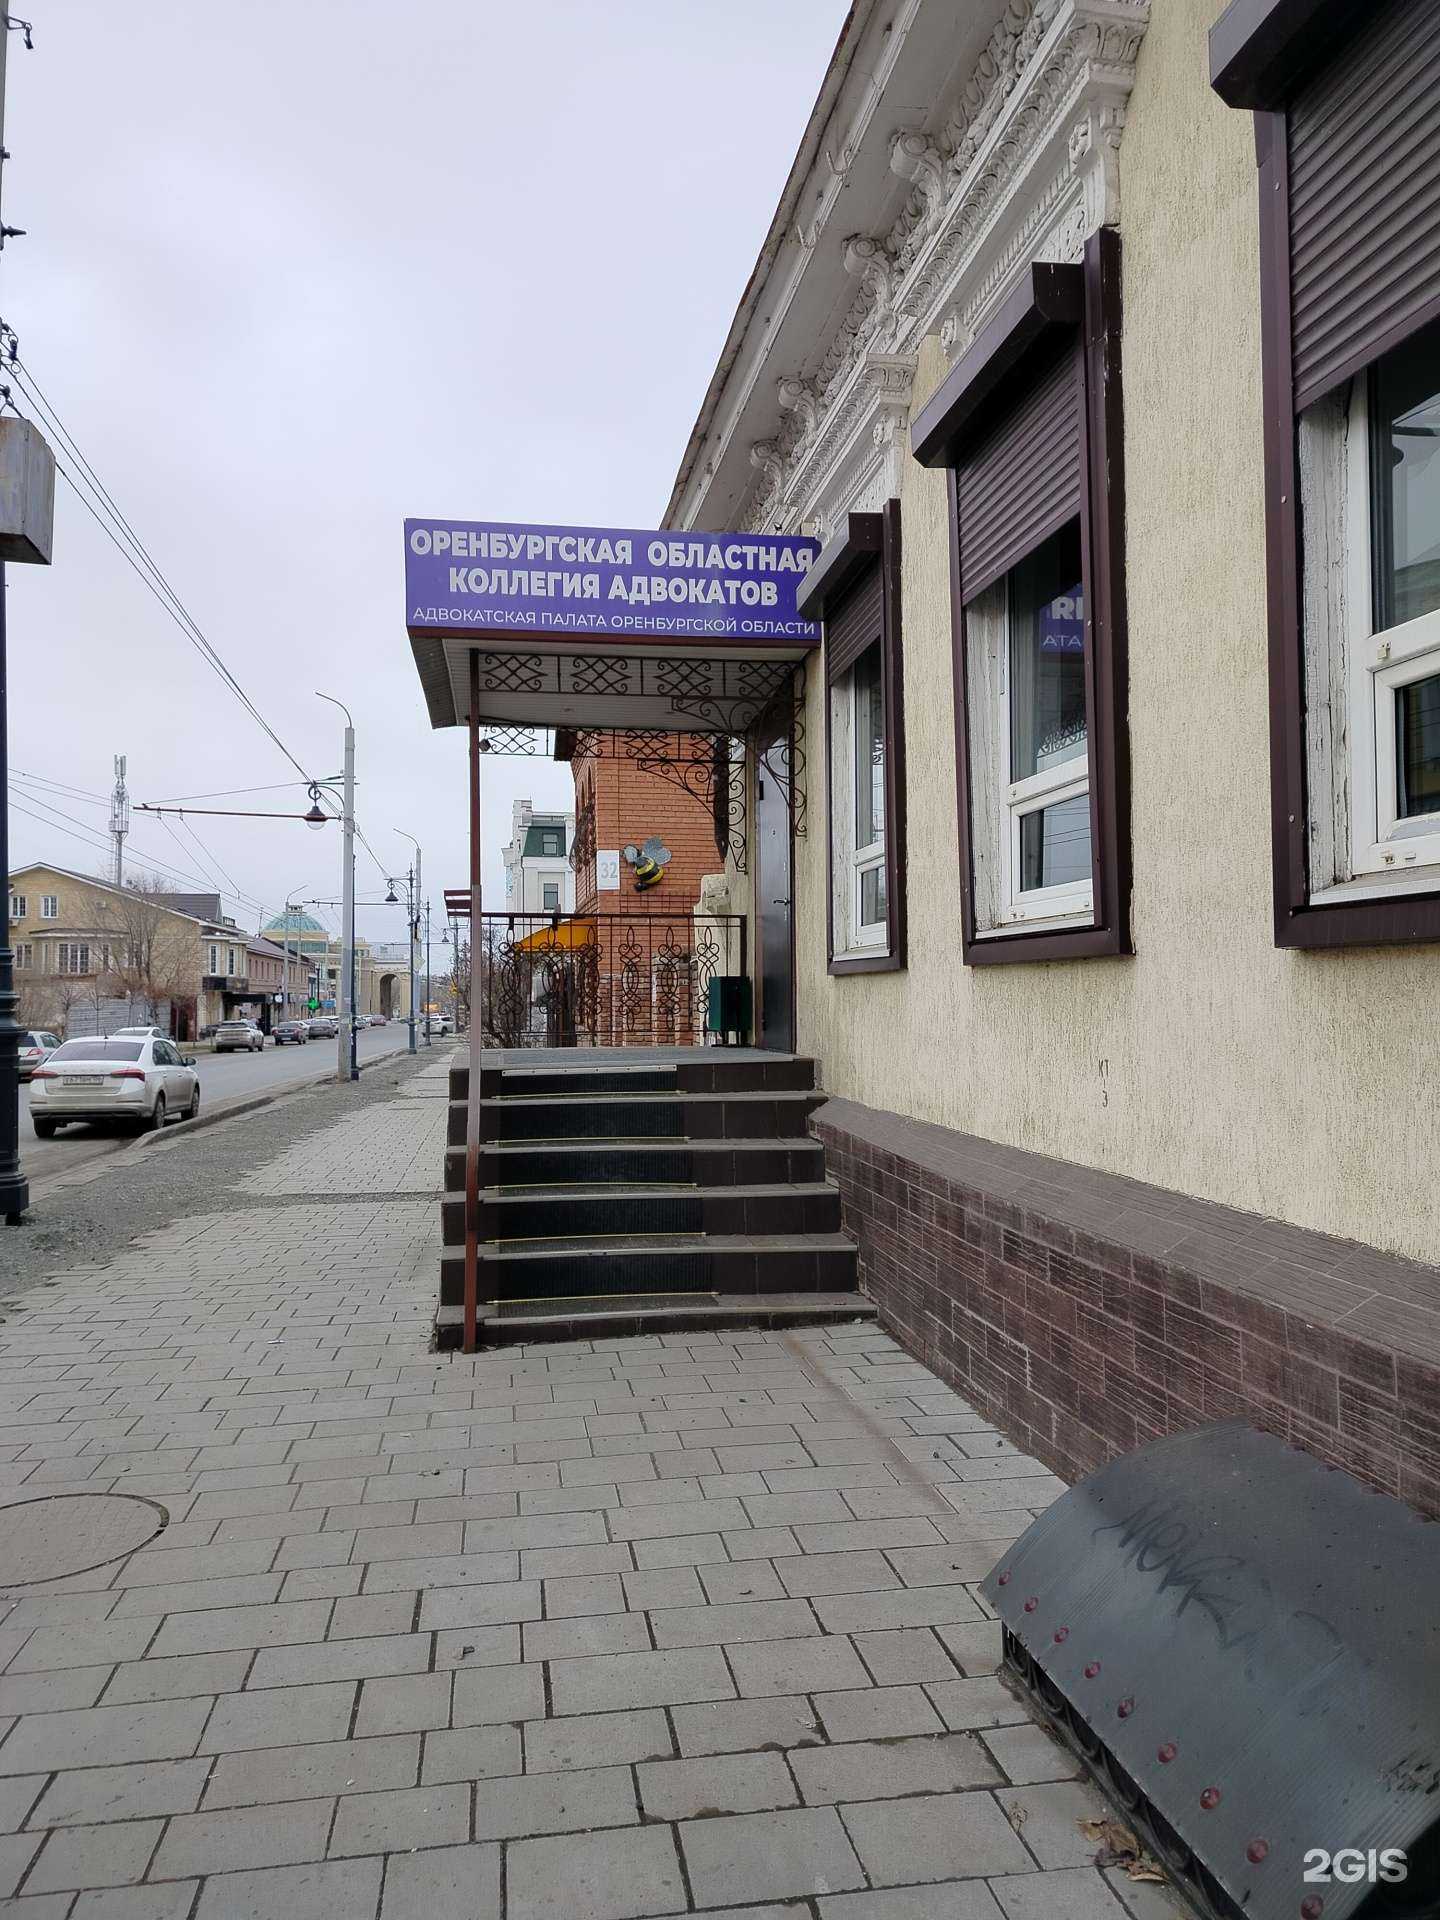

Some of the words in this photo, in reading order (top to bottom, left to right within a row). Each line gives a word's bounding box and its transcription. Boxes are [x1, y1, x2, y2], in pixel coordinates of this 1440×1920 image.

[410, 529, 633, 564] ОРЕНБУРГСКАЯ
[648, 540, 814, 573] ОБЛАСТНАЯ
[449, 568, 600, 598] КОЛЛЕГИЯ
[608, 575, 778, 606] АДВОКАТОВ
[413, 607, 536, 624] АДВОКАТСКАЯ
[541, 612, 608, 628] ПАЛАТА
[611, 615, 737, 633] ОРЕНБУРГСКОЙ
[741, 620, 815, 635] ОБЛАСТИ
[600, 862, 618, 879] 32
